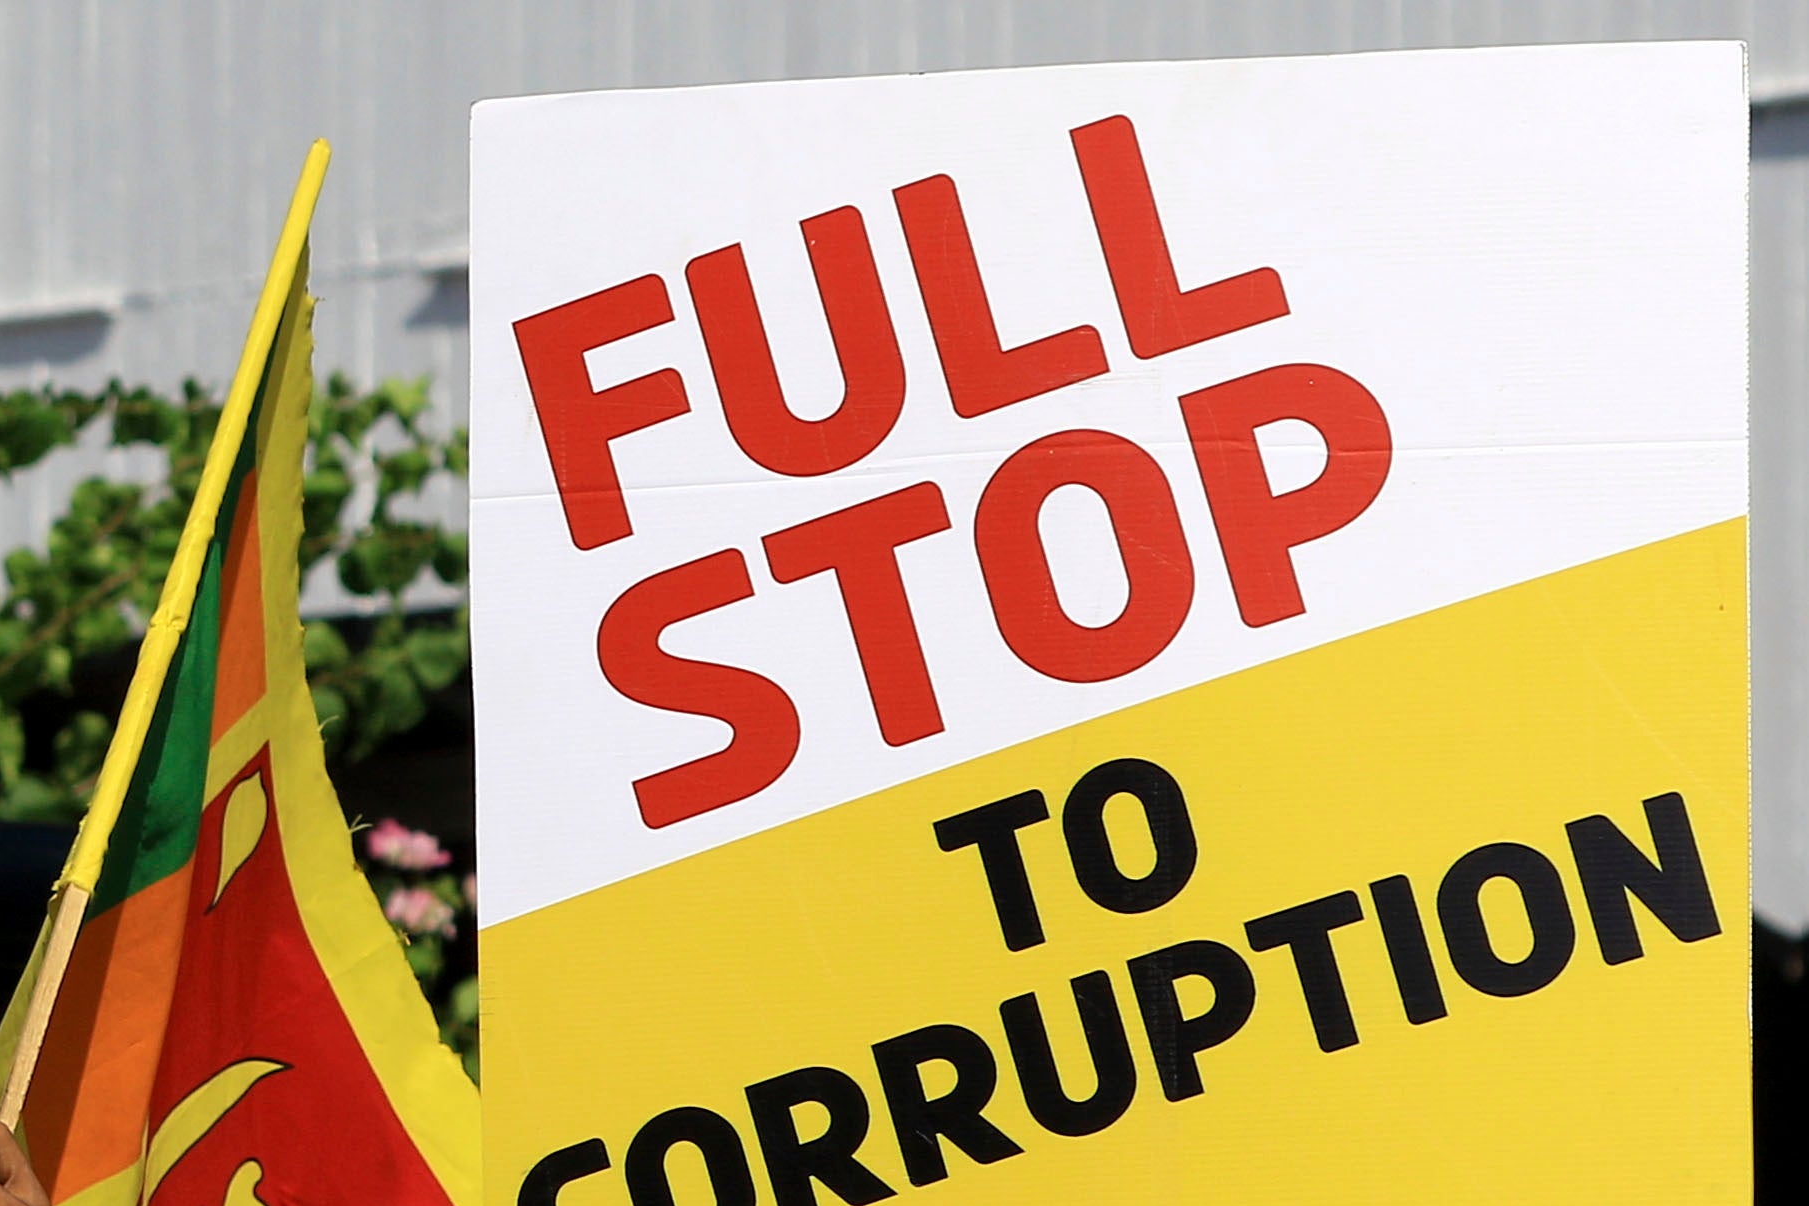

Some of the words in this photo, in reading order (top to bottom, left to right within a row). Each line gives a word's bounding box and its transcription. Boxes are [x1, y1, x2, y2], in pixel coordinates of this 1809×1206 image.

[515, 113, 1291, 551] FULL
[597, 362, 1393, 830] STOP
[932, 757, 1198, 952] TO
